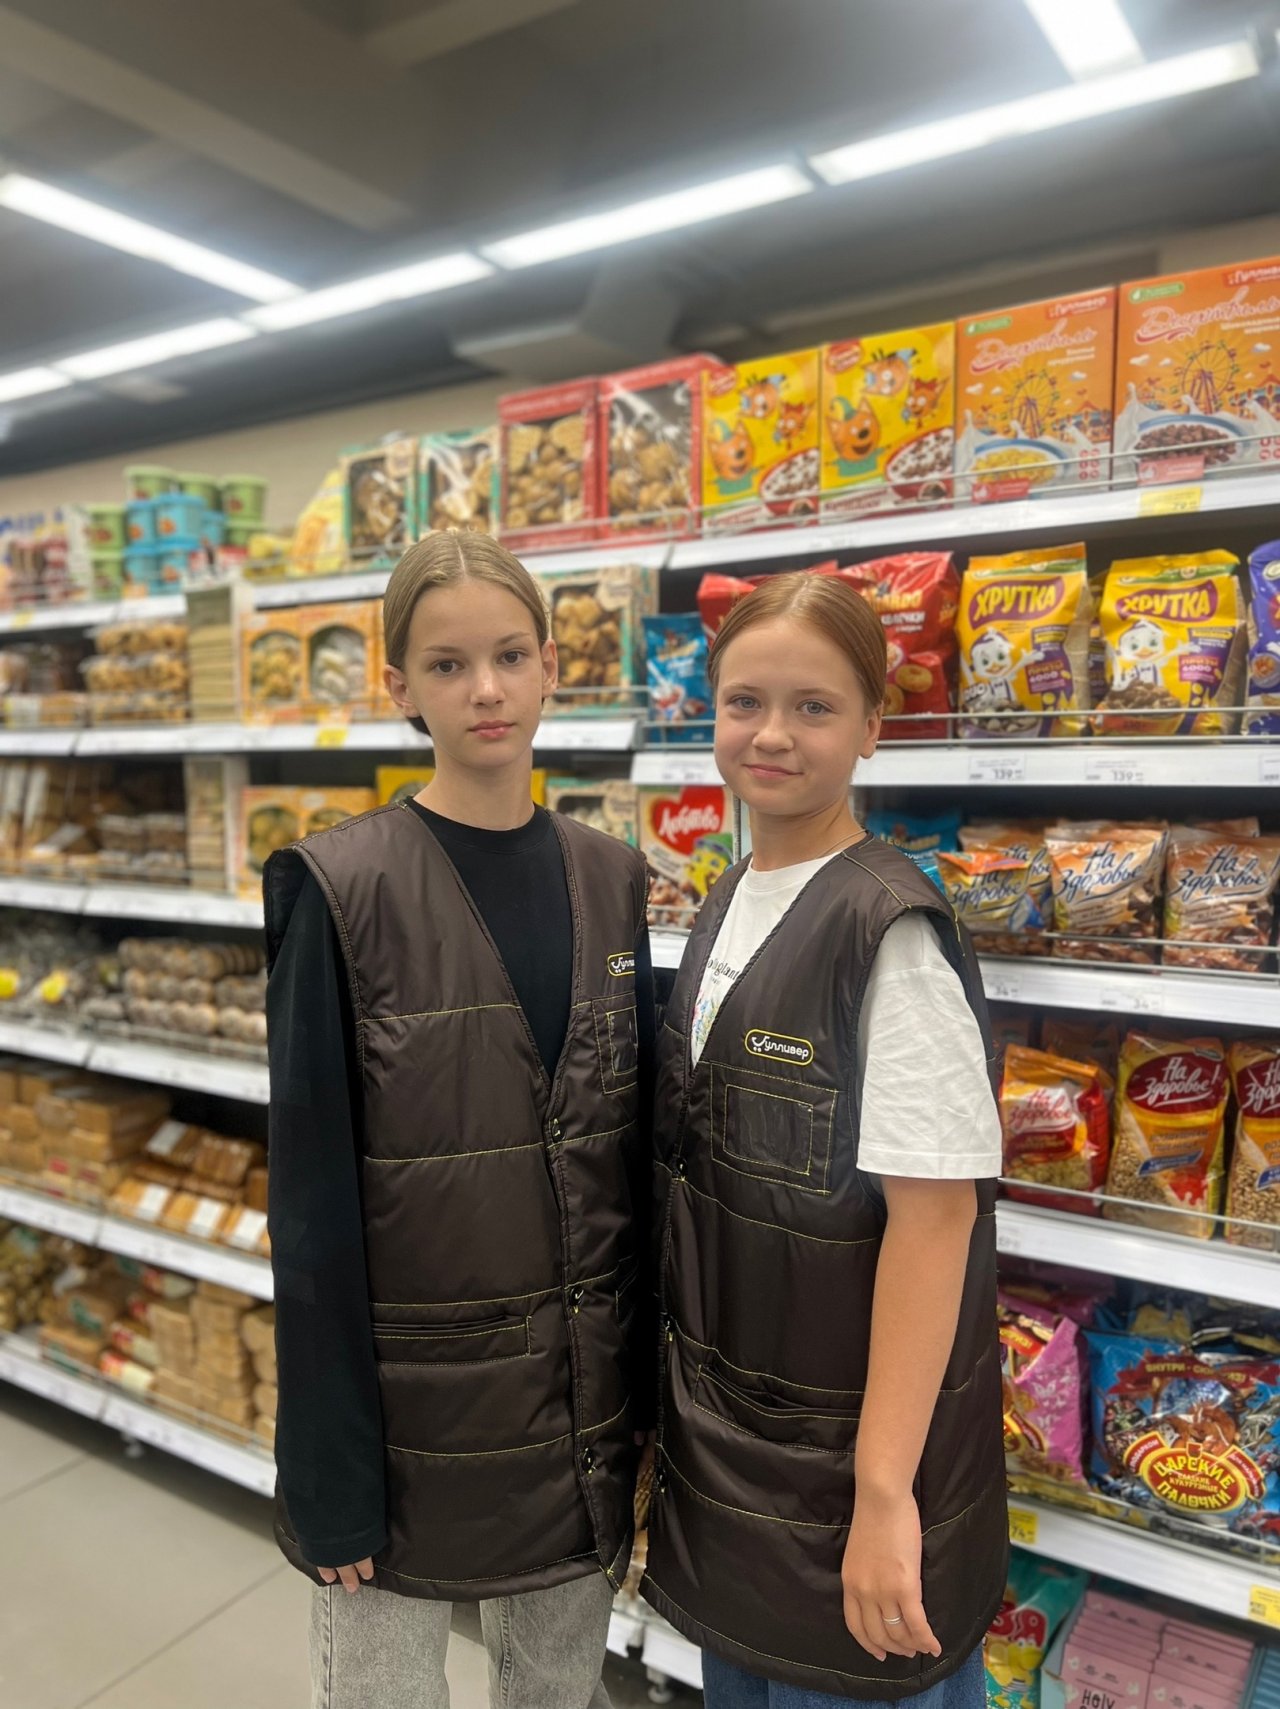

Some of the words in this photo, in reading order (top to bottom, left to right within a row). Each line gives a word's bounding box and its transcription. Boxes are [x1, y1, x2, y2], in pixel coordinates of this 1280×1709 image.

[973, 585, 1057, 621] ХРУТКА
[1121, 589, 1211, 618] ХРУТКА
[1085, 843, 1115, 873] На
[1206, 844, 1236, 873] На
[752, 1036, 809, 1060] Гулливер
[1162, 1057, 1187, 1081] На
[1153, 1455, 1235, 1489] ЦАРСКИЕ
[1157, 1481, 1232, 1509] ПАЛОЧКИ
